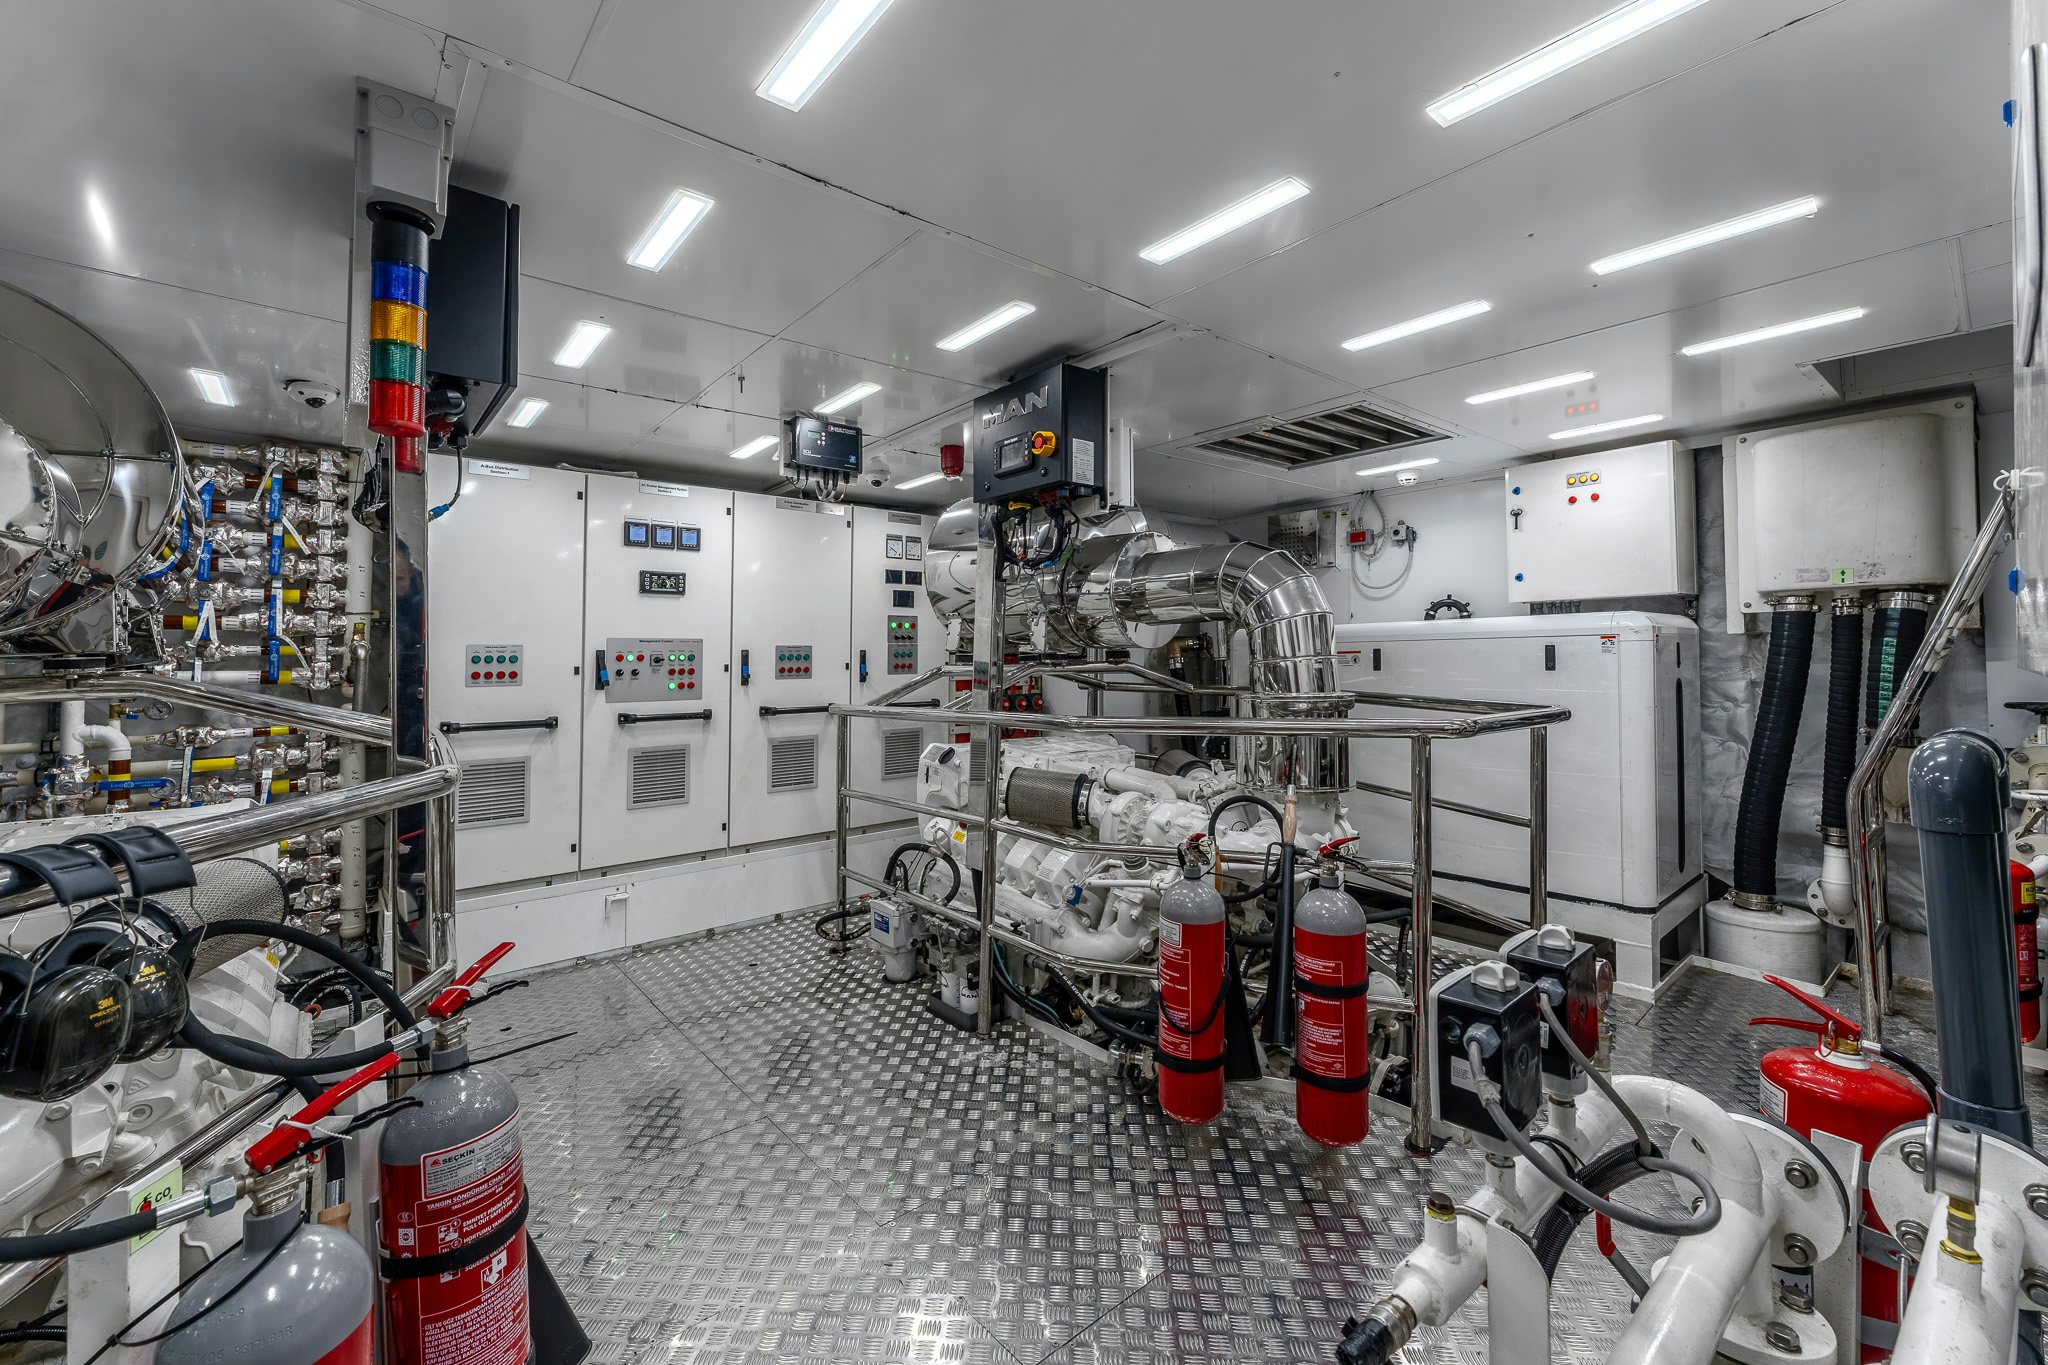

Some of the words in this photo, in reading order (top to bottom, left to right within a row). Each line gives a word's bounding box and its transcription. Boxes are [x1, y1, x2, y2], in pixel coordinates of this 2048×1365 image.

[982, 385, 1048, 430] MAN
[140, 964, 156, 976] 3M
[98, 996, 113, 1010] 3M
[89, 1004, 121, 1019] PELTOR
[442, 1148, 475, 1164] SEÇKİN
[427, 1198, 452, 1210] YANGIN
[453, 1182, 488, 1203] SÖNDÜRME
[463, 1212, 487, 1227] EMNİYET
[464, 1224, 478, 1232] PULL
[478, 1218, 489, 1226] OUT
[490, 1206, 506, 1219] SAFETY
[464, 1226, 492, 1243] HORTUMU
[481, 1285, 500, 1301] DİKKAT
[445, 1320, 464, 1330] TEMAS
[426, 1351, 439, 1359] ONLY
